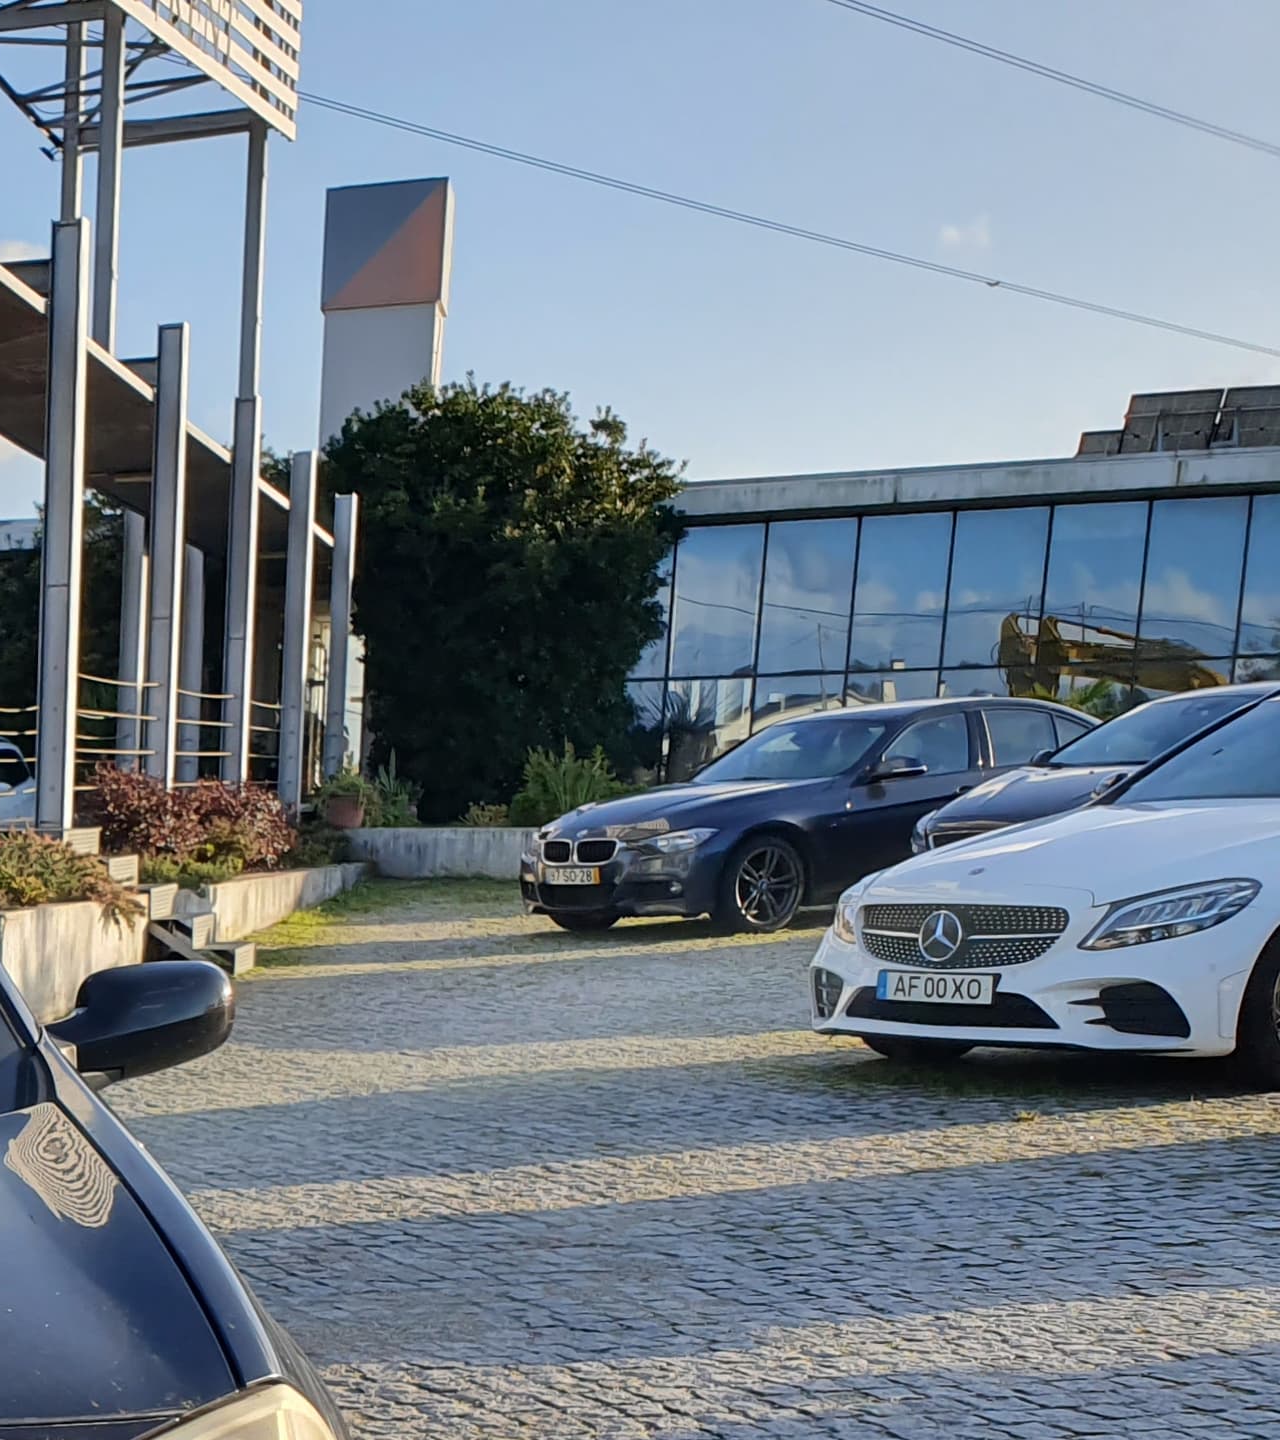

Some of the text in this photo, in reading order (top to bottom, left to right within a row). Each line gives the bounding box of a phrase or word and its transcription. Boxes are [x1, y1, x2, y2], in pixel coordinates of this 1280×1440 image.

[893, 975, 981, 999] AF 00 XO
